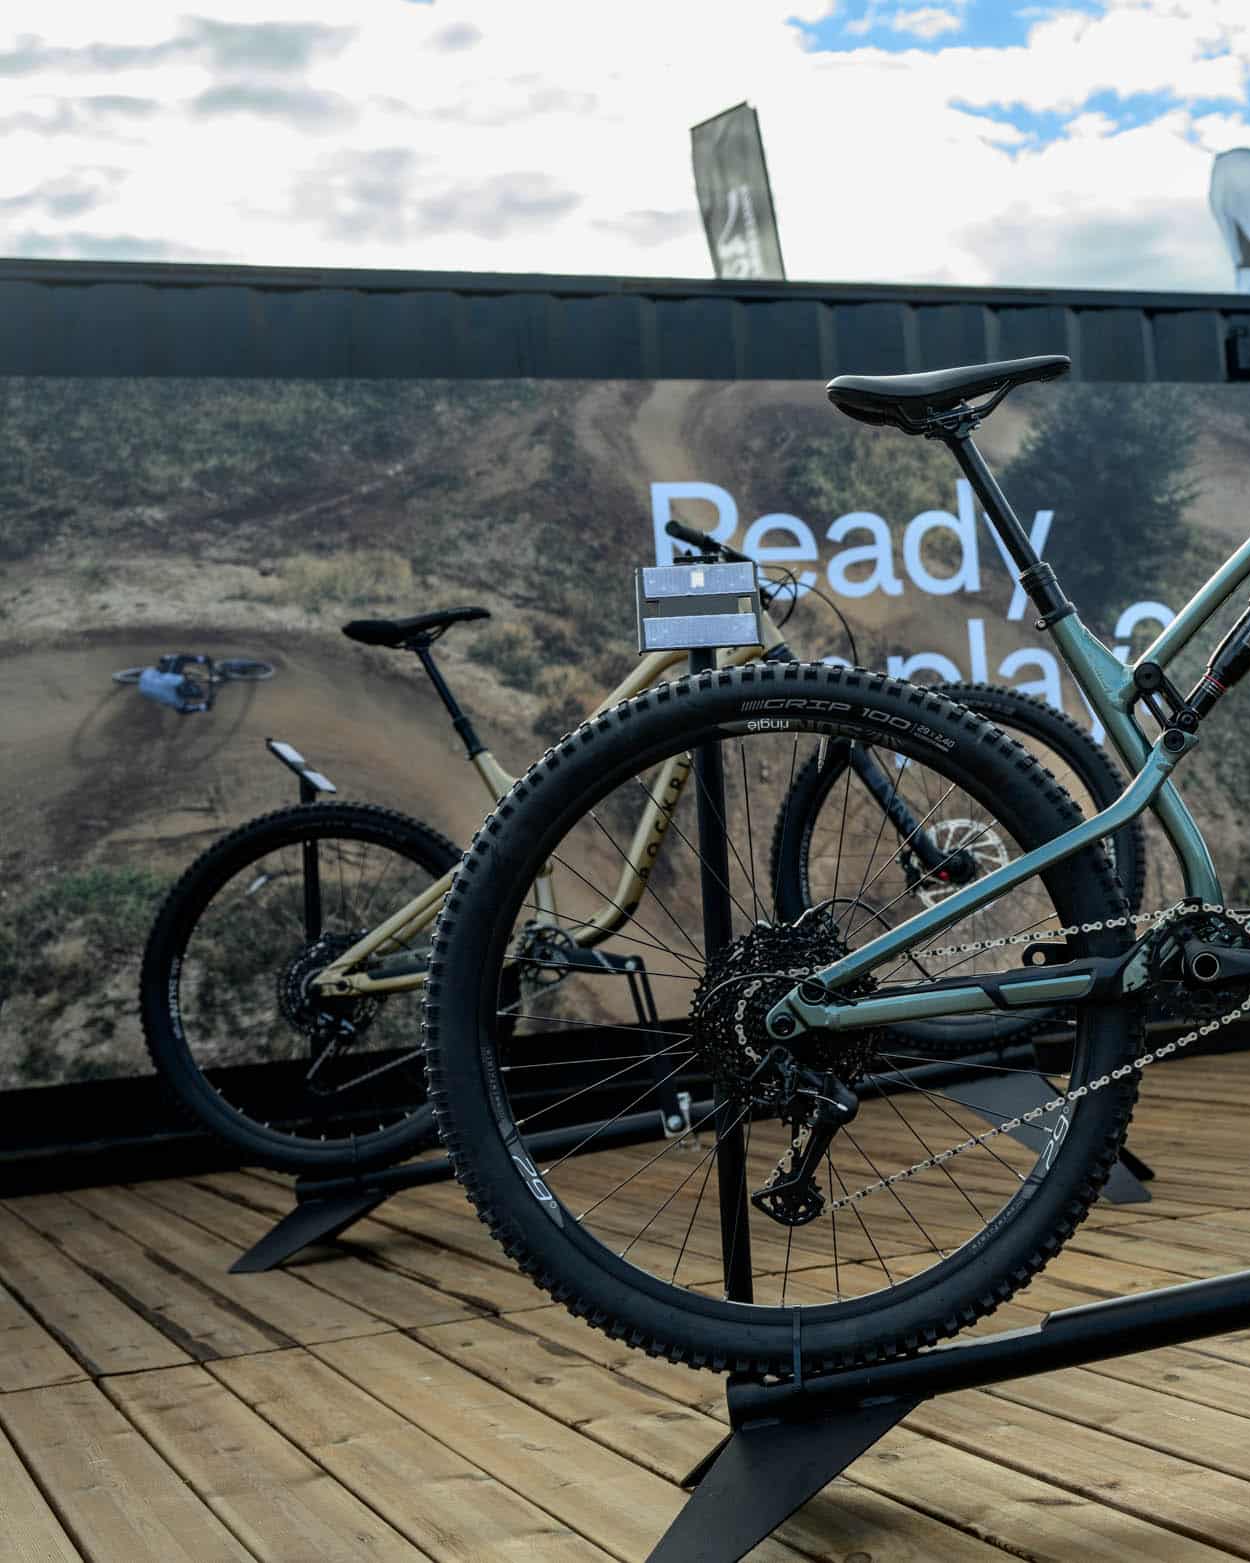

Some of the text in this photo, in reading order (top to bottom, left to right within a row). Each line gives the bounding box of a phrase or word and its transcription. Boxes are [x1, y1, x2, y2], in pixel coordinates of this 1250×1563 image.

[649, 478, 1055, 621] Ready
[763, 698, 851, 712] GRIP
[861, 707, 912, 731] 100
